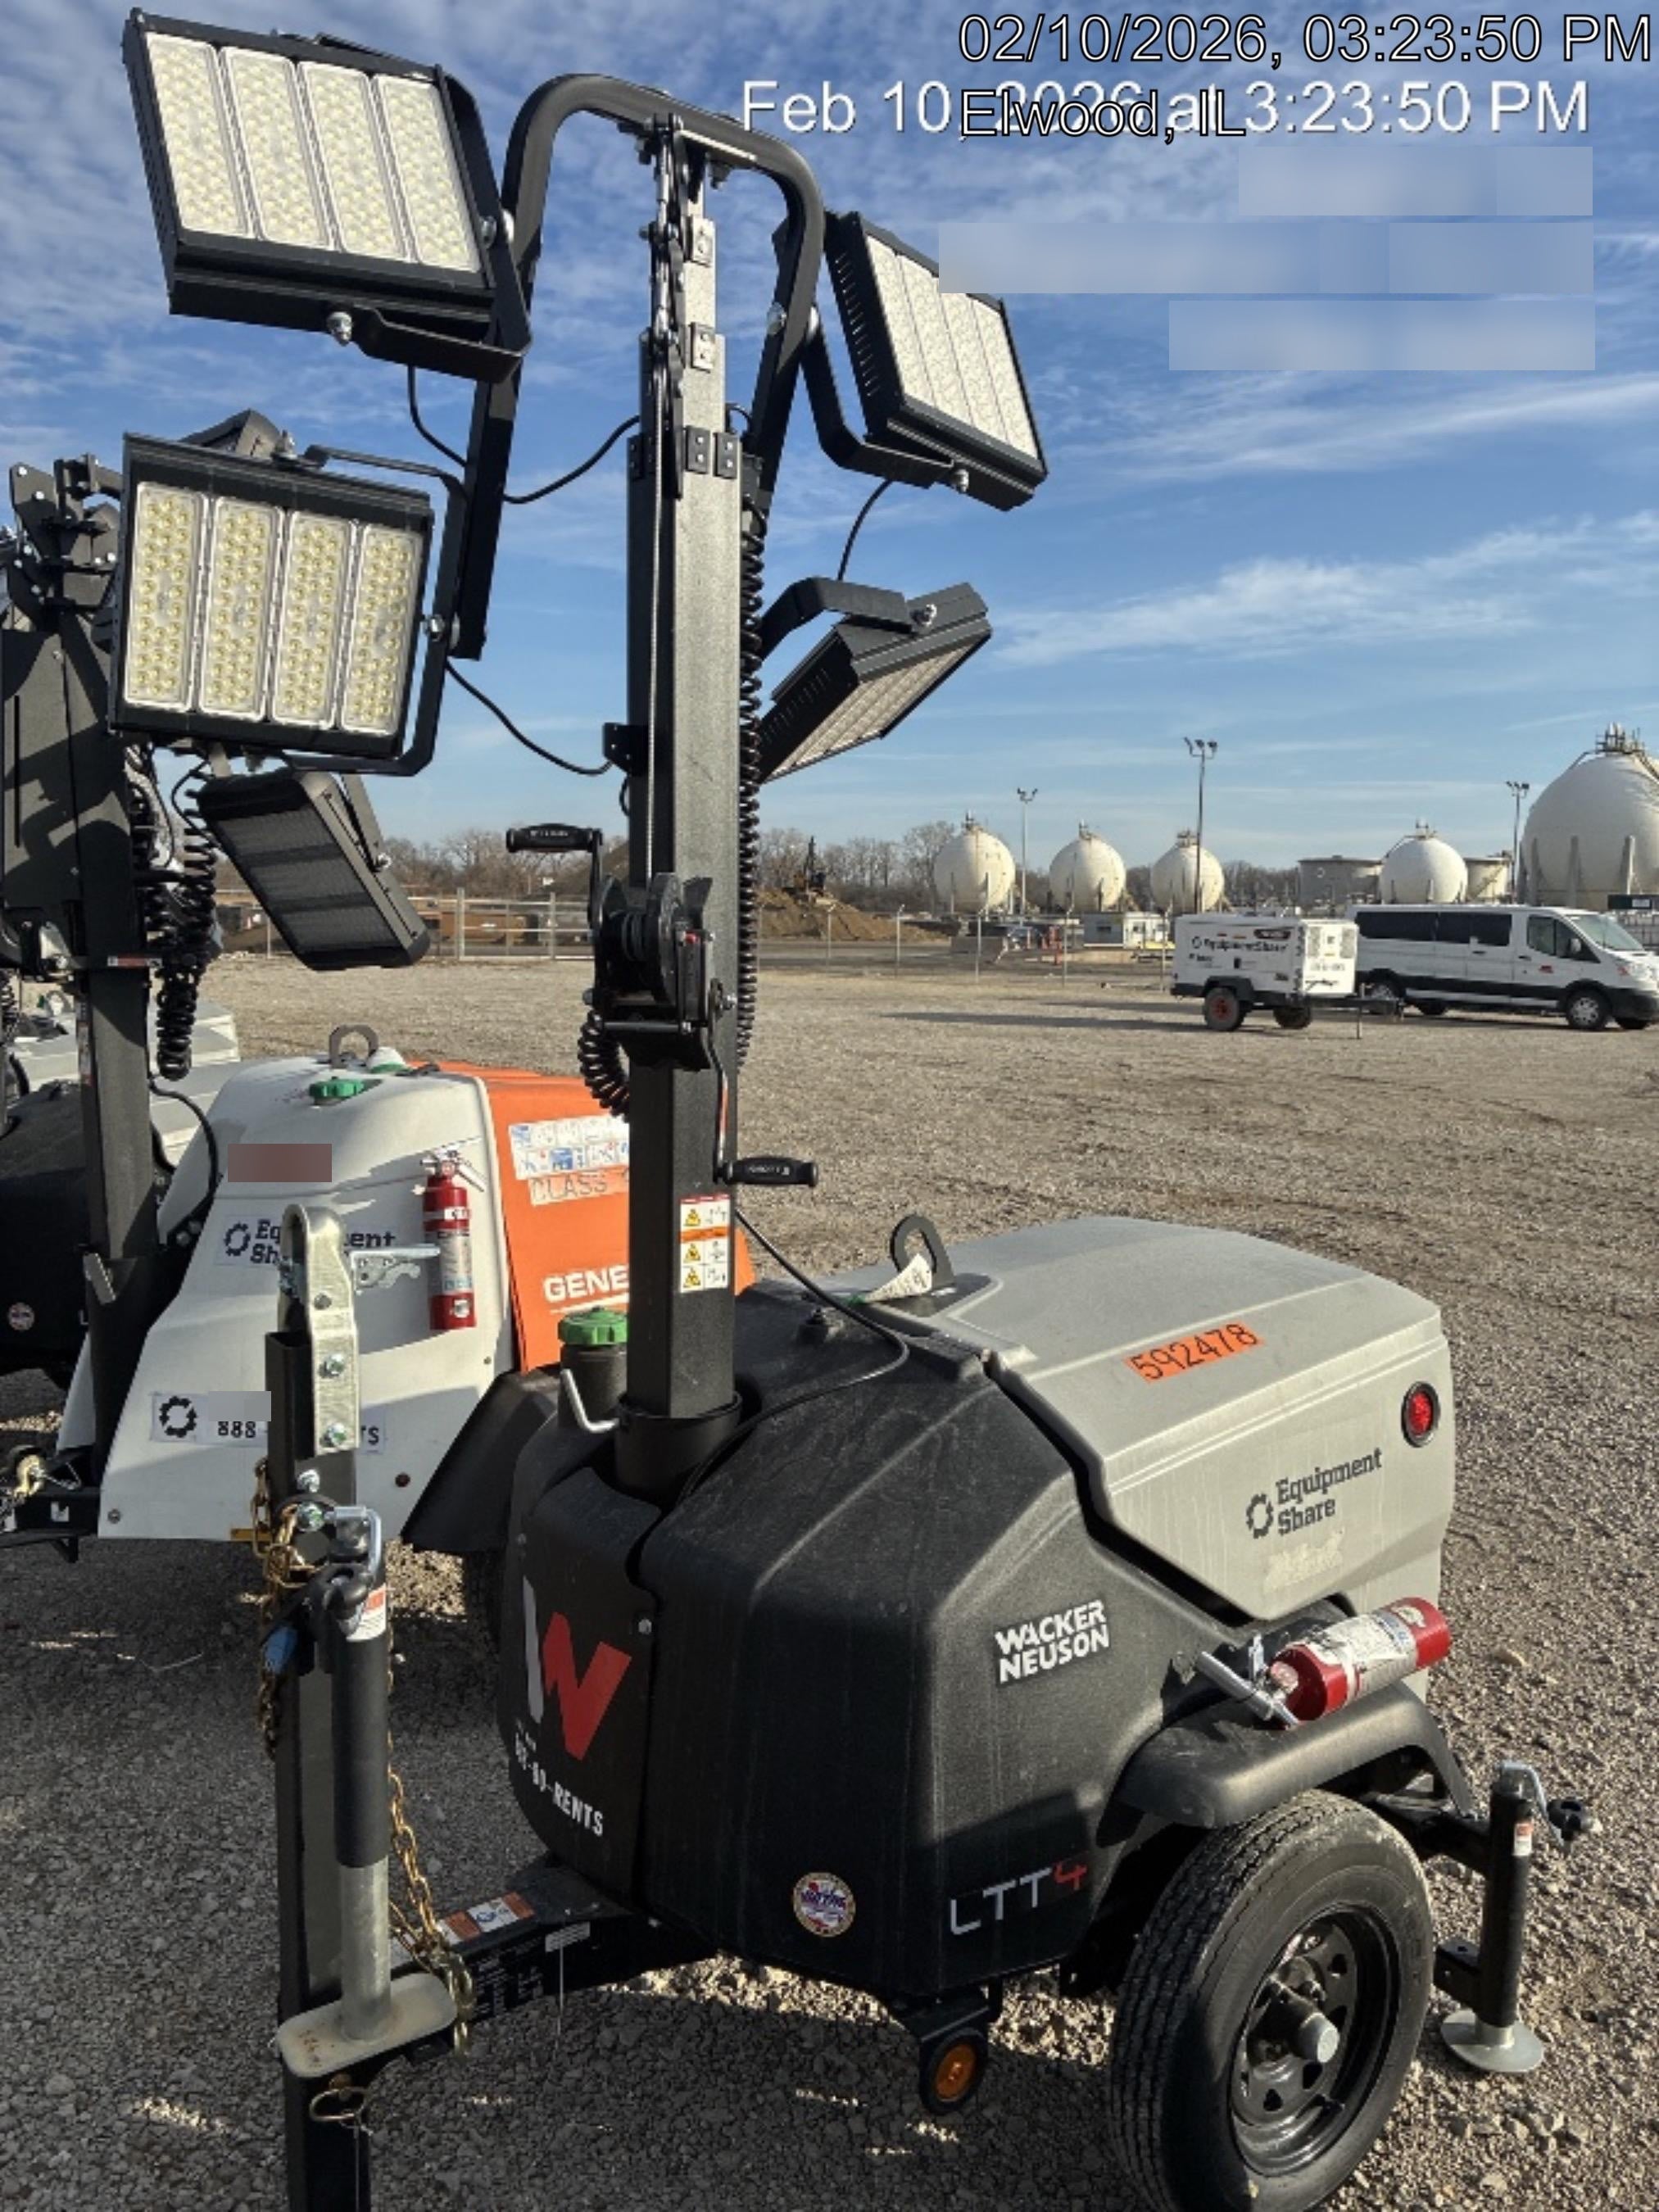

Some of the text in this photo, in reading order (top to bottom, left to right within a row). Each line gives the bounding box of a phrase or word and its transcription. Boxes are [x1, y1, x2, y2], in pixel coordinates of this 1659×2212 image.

[542, 1265, 629, 1303] GENE
[1130, 1322, 1258, 1380] 592478
[1275, 1448, 1383, 1506] Equipment
[1276, 1496, 1336, 1538] Share
[995, 1599, 1106, 1656] WACKER
[999, 1625, 1110, 1684] NEUSON
[950, 1860, 1088, 1936] LTT4
